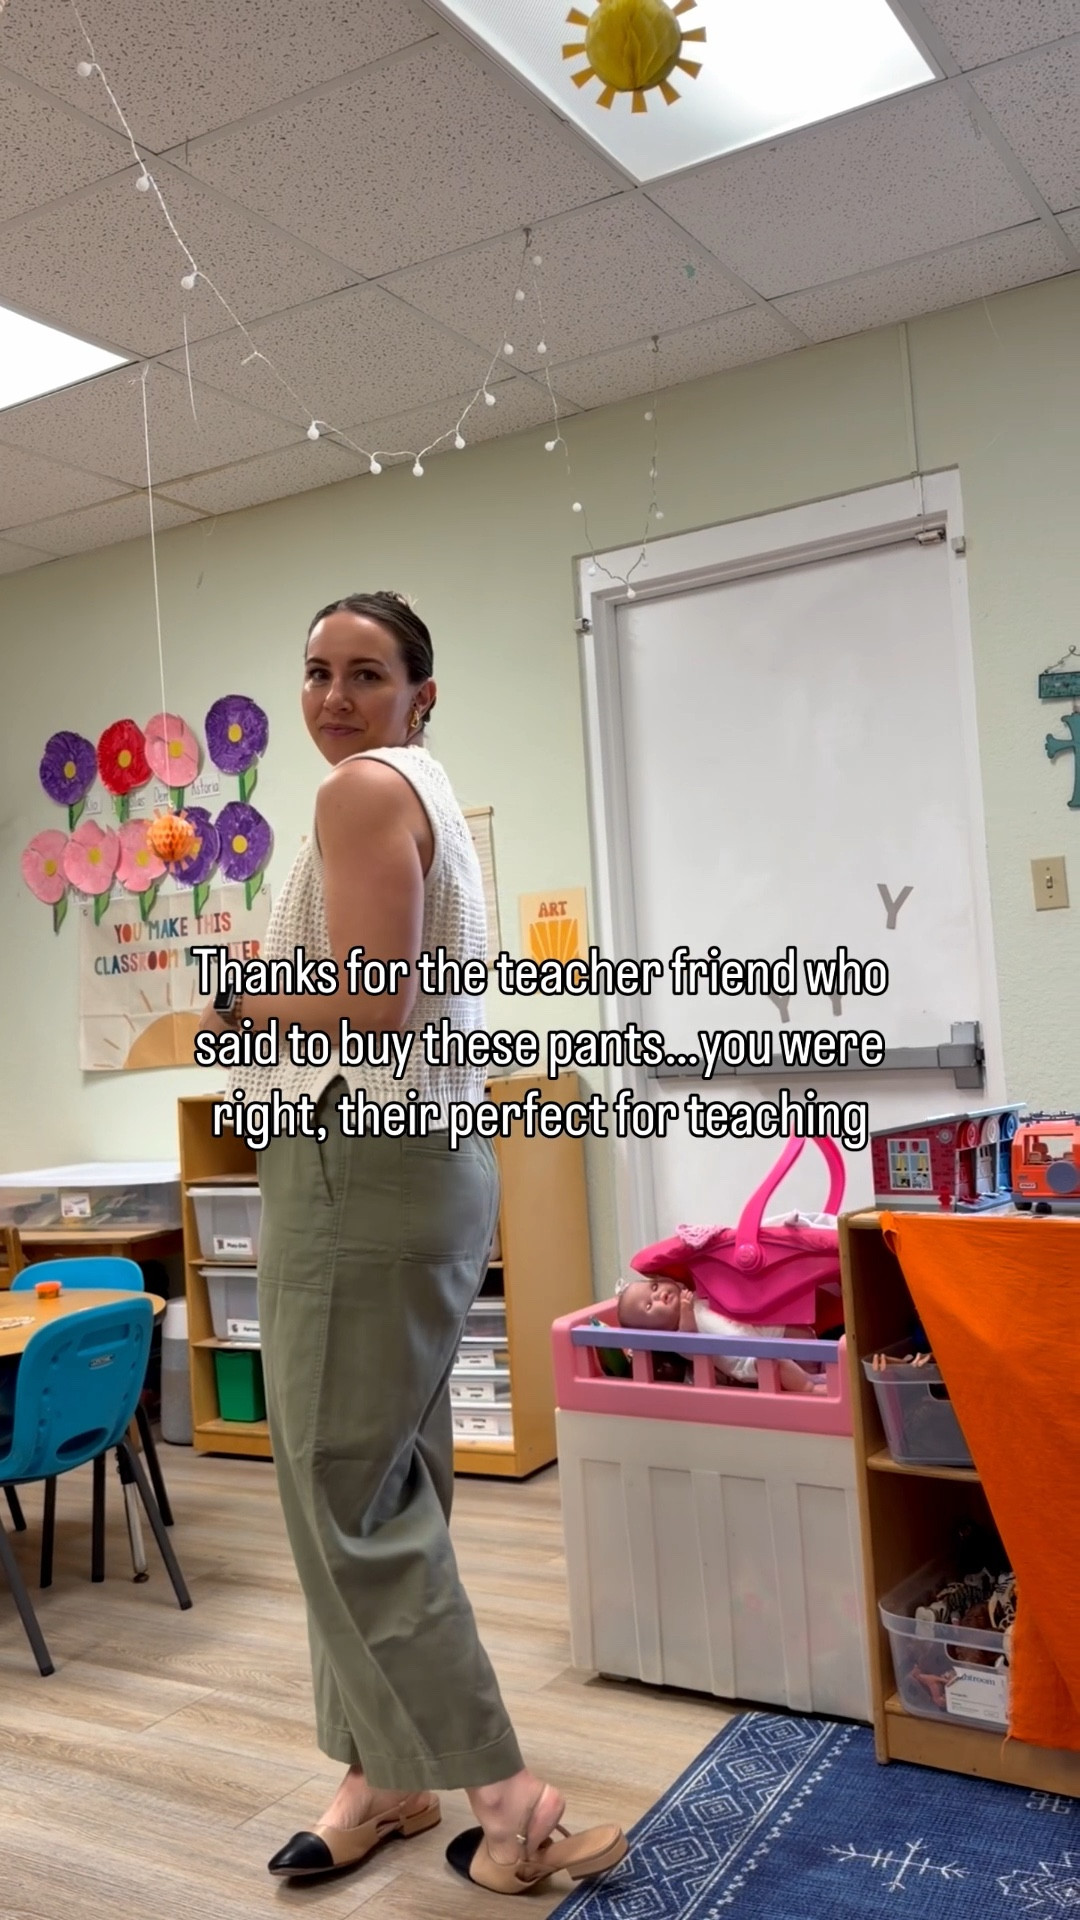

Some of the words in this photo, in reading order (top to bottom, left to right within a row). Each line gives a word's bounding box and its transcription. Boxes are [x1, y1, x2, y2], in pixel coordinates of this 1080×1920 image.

[538, 901, 568, 918] ART
[876, 883, 914, 930] Y
[114, 923, 142, 944] YOU
[148, 917, 188, 940] MAKE
[195, 912, 232, 937] THIS
[94, 948, 179, 976] CLASSROOM
